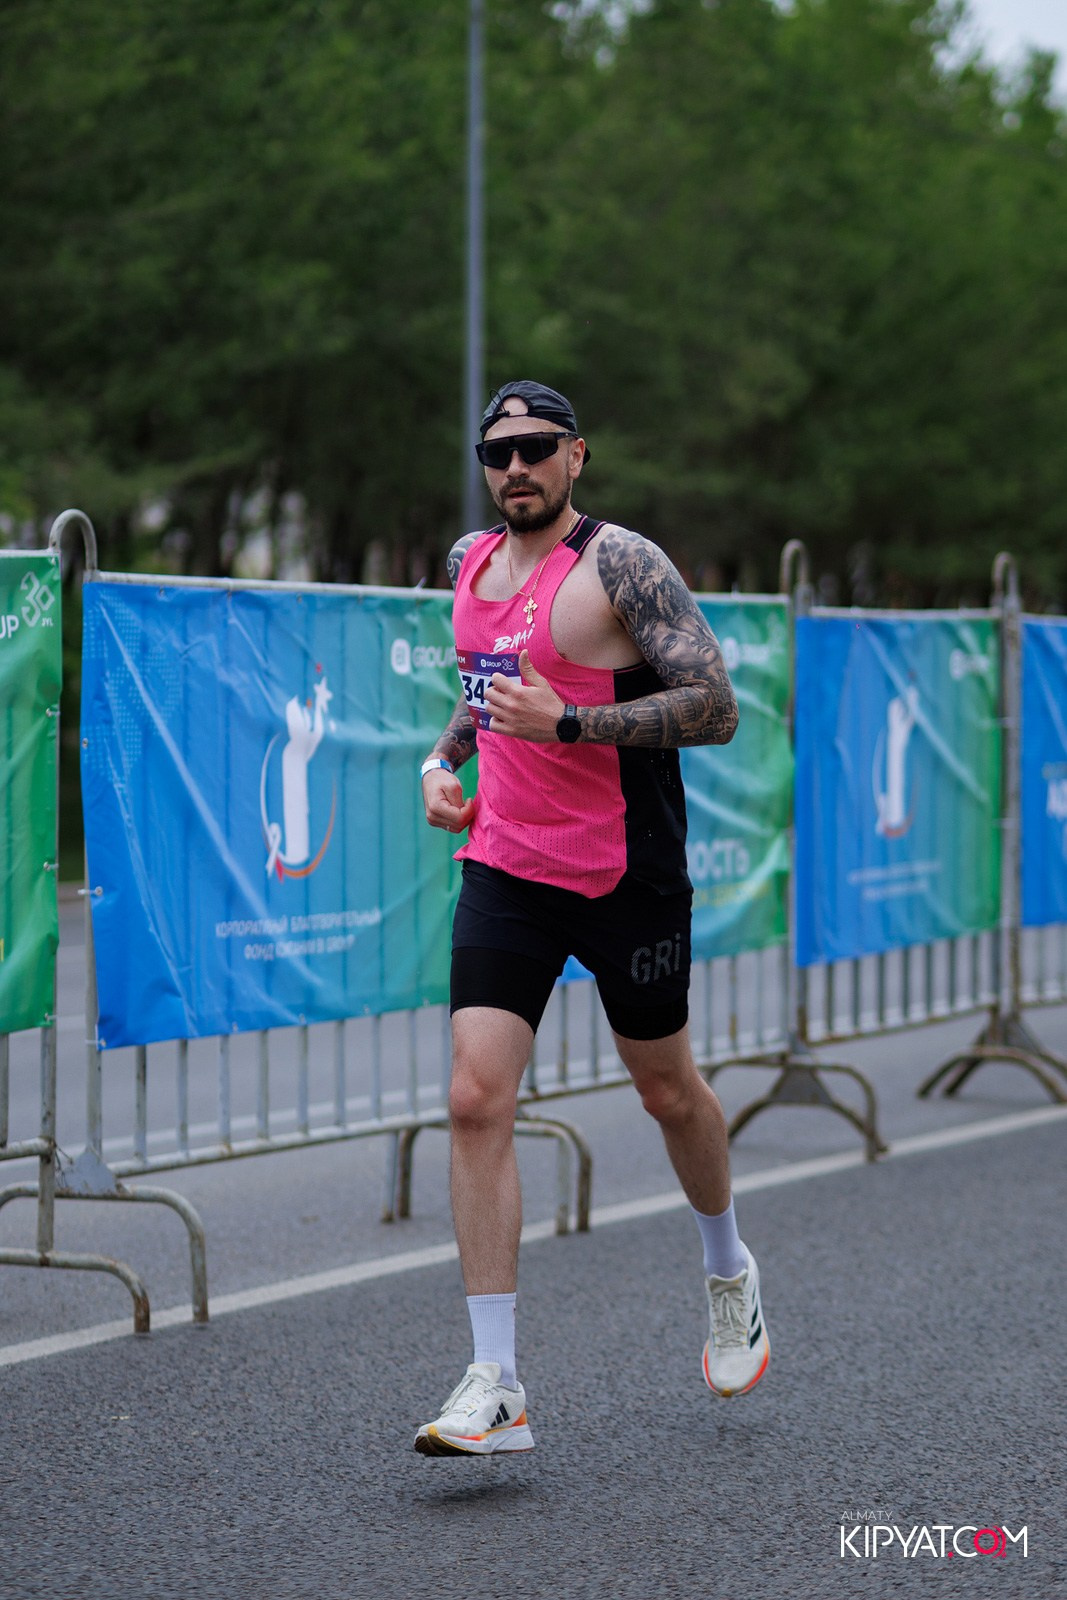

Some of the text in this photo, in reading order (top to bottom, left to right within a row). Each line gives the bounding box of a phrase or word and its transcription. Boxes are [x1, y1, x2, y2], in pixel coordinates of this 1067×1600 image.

[486, 660, 502, 668] GROUP
[462, 675, 494, 705] 34
[686, 838, 750, 880] ОСТЬ
[244, 942, 275, 960] ФОНД
